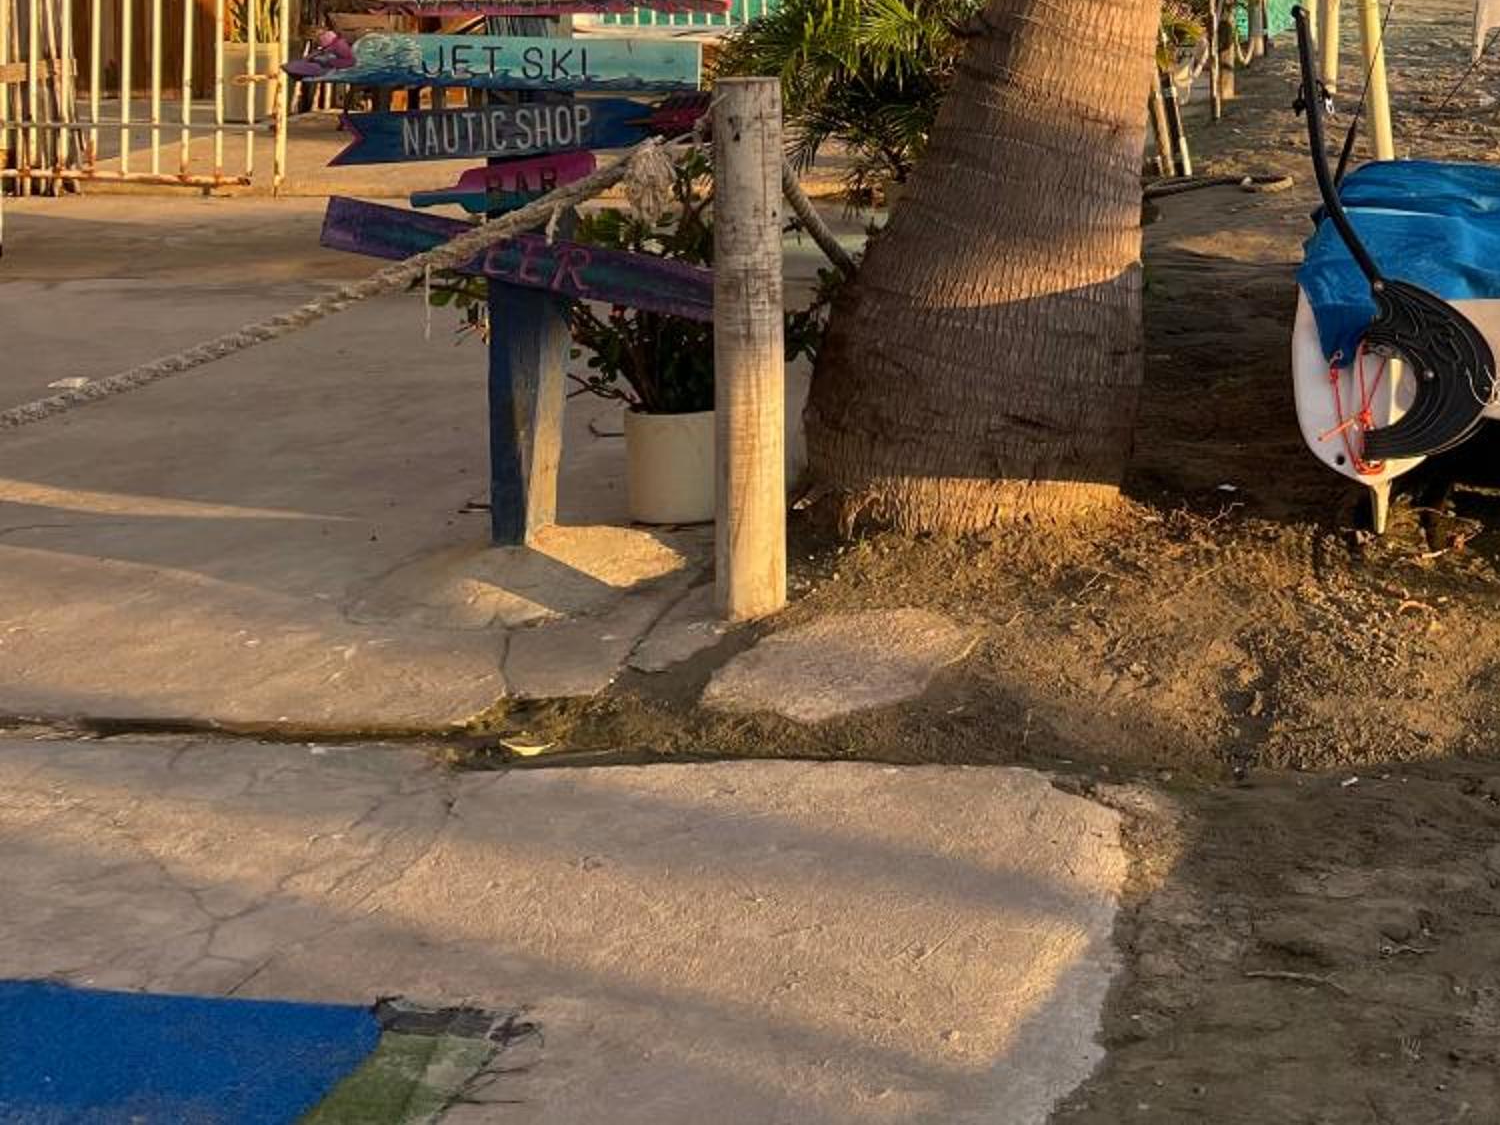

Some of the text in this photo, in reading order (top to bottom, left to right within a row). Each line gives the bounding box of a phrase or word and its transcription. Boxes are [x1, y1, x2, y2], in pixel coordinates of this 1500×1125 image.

[421, 45, 588, 81] JET SKI
[402, 105, 593, 156] NAUTIC SHOP
